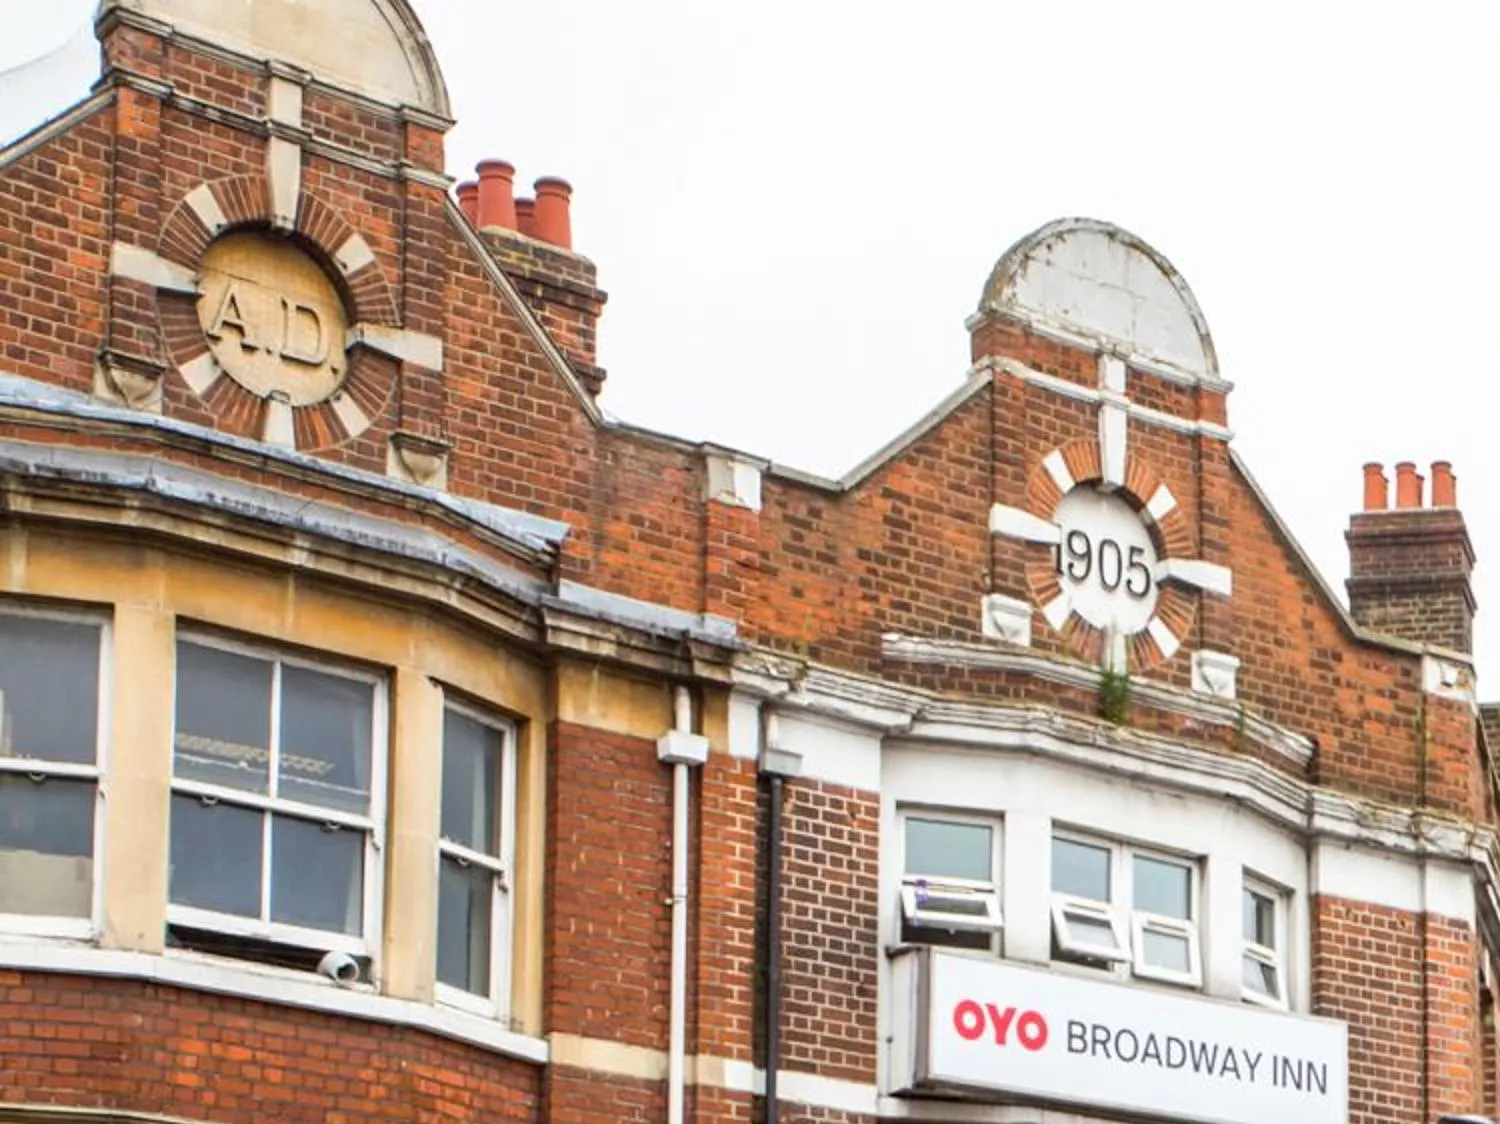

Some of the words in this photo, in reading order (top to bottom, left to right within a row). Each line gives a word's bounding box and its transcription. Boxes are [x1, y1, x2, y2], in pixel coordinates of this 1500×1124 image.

[953, 1000, 1048, 1051] OYO
[1067, 1020, 1262, 1082] BROADWAY
[1272, 1056, 1328, 1095] INN
